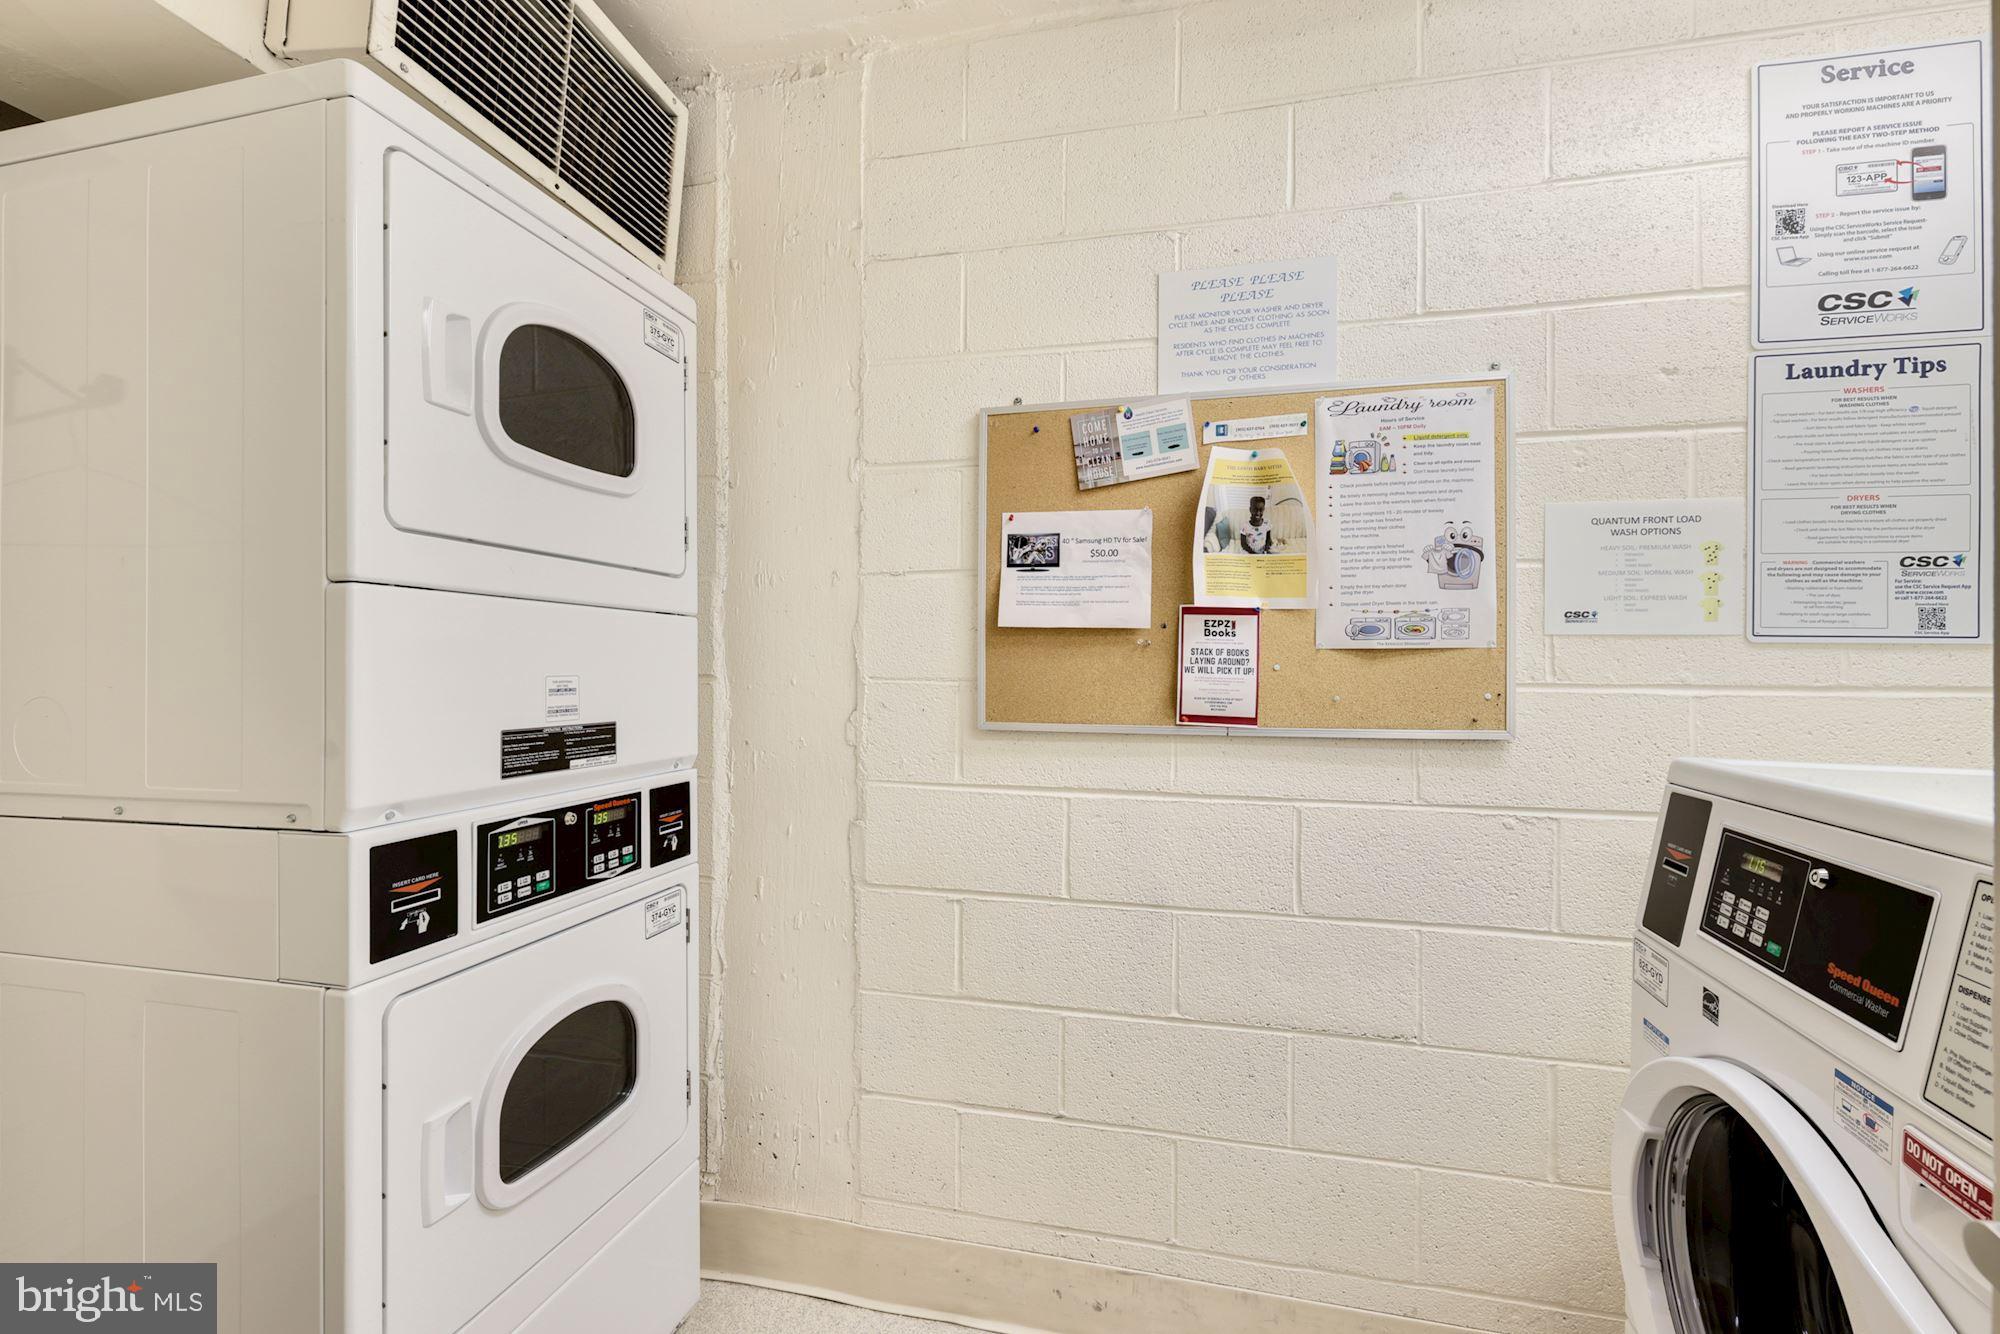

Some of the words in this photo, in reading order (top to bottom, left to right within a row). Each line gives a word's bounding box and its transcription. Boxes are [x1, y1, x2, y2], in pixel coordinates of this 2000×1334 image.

[1821, 59, 1915, 84] Service
[1800, 108, 1832, 118] PROPERLY
[1833, 105, 1865, 115] WORKING
[1866, 102, 1900, 112] MACHINES
[1921, 97, 1951, 106] PRIORITY
[1802, 102, 1819, 110] YOUR
[1820, 97, 1866, 108] SATISFACTION
[1874, 93, 1913, 103] IMPORTANT
[1797, 135, 1837, 145] FOLLOWING
[1852, 132, 1870, 140] EASY
[1872, 129, 1907, 138] TWO-STEP
[1908, 126, 1939, 135] METHOD
[1812, 128, 1837, 137] PLEASE
[1838, 125, 1865, 134] REPORT
[1873, 122, 1901, 131] SERVICE
[1902, 120, 1922, 128] ISSUE
[1846, 173, 1888, 184] 123-APP
[1191, 277, 1245, 291] PLEASE
[1250, 271, 1304, 285] PLEASE
[1220, 289, 1274, 302] PLEASE
[1818, 290, 1893, 312] CSC
[1168, 321, 1188, 329] CYCLE
[1190, 319, 1208, 328] TIMES
[1227, 315, 1255, 324] REMOVE
[1257, 312, 1293, 321] CLOTHING
[1306, 308, 1330, 317] SOON
[1174, 312, 1196, 321] PLEASE
[1197, 310, 1230, 319] MONITOR
[1232, 308, 1251, 316] YOUR
[1252, 305, 1282, 314] WASHER
[1301, 302, 1323, 310] DRYER
[1173, 341, 1206, 350] RESIDENTS
[1245, 335, 1276, 344] CLOTHES
[1288, 331, 1324, 340] MACHINES
[1195, 348, 1216, 356] CYCLE
[1225, 344, 1259, 353] COMPLETE
[1210, 353, 1237, 362] REMOVE
[1259, 361, 1316, 372] CONSIDERATION
[1785, 359, 1887, 381] Laundry
[1893, 356, 1947, 378] Tips
[1328, 398, 1423, 417] Laundry
[1429, 396, 1476, 407] room
[1083, 419, 1106, 433] COME
[1083, 433, 1109, 447] HOME
[1088, 454, 1112, 467] CLEAN
[1088, 466, 1114, 480] HOUSE
[1591, 516, 1640, 526] QUANTUM
[1642, 516, 1673, 524] FRONT
[1676, 515, 1701, 523] LOAD
[1610, 528, 1637, 536] WASH
[1640, 527, 1681, 536] OPTIONS
[1090, 548, 1118, 558] $50.00
[1900, 556, 1949, 567] CSC
[1204, 629, 1236, 637] Books
[392, 879, 411, 888] INSERT
[1827, 962, 1862, 988] Speed
[1862, 979, 1900, 1007] Queen
[1829, 979, 1865, 1004] Commercial
[1865, 998, 1890, 1018] Washer
[1850, 1080, 1876, 1102] NOTICE
[1906, 1138, 1921, 1158] DO
[1922, 1149, 1944, 1175] NOT
[1946, 1168, 1978, 1201] OPEN
